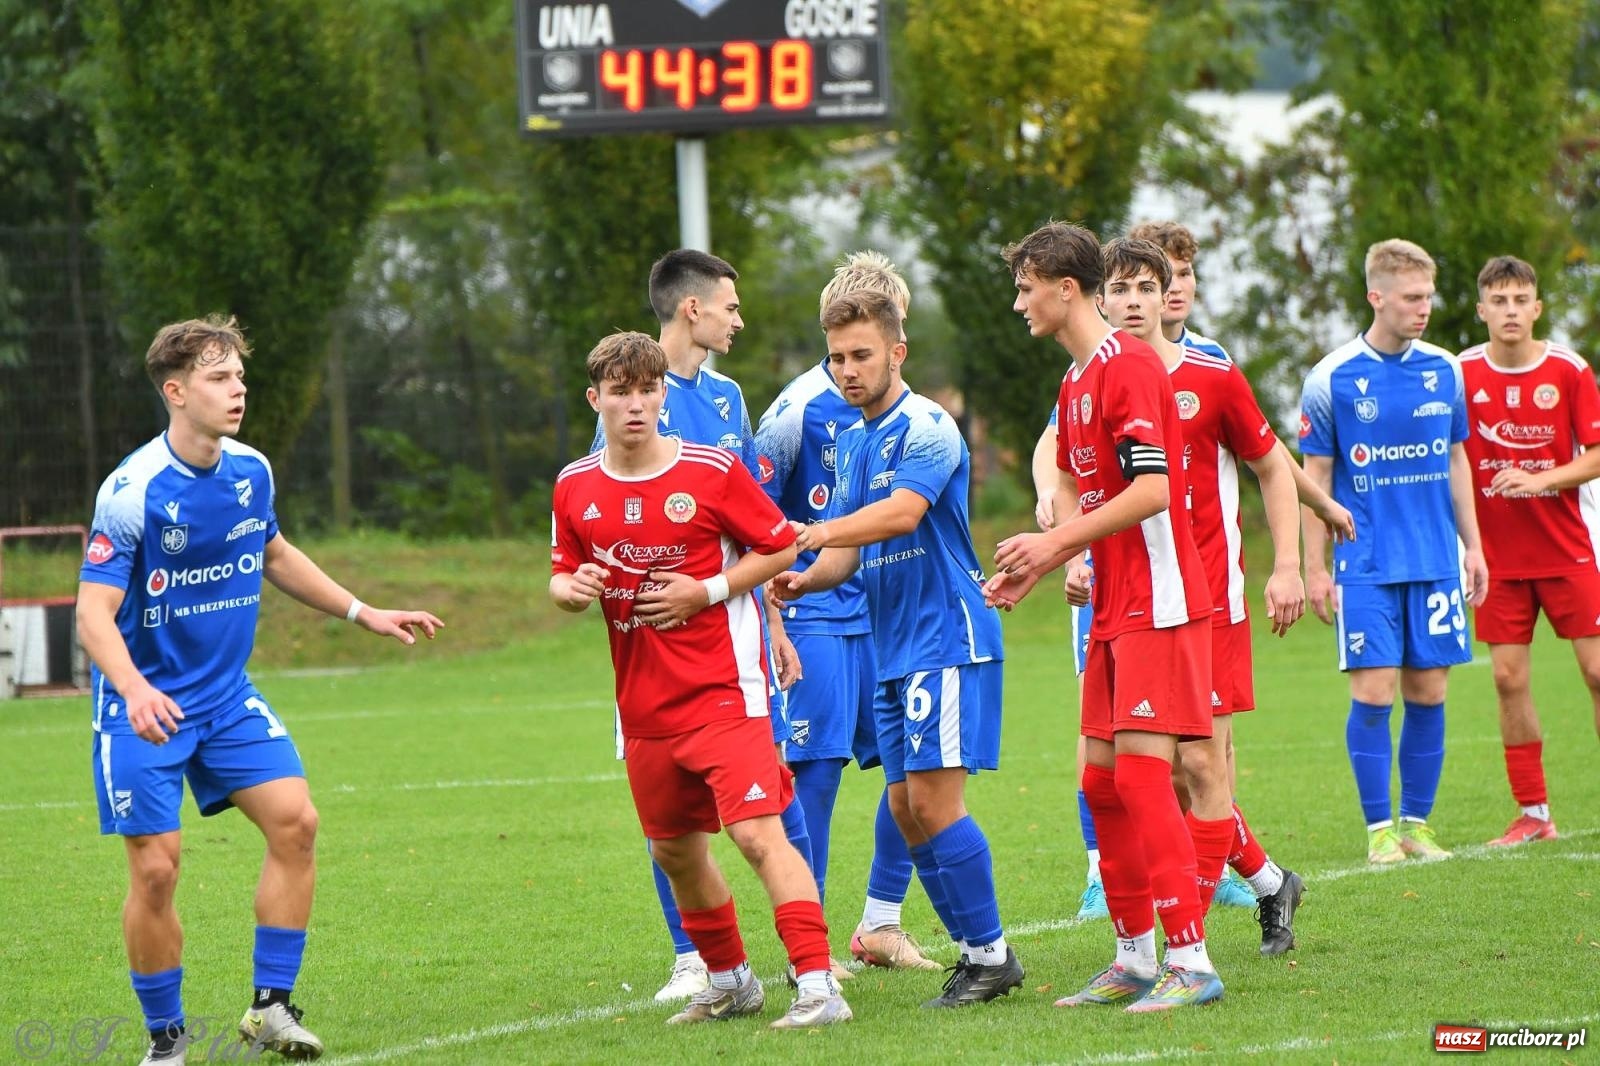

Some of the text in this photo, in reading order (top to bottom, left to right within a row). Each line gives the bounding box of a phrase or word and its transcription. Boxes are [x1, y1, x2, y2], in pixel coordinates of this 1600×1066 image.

[538, 5, 614, 48] UNIA
[602, 39, 812, 112] 44:38
[1372, 443, 1428, 462] Marco
[620, 543, 687, 562] REKPOL
[171, 563, 234, 588] Marco
[174, 606, 190, 618] MB
[1427, 588, 1466, 636] 23
[906, 671, 931, 722] 6
